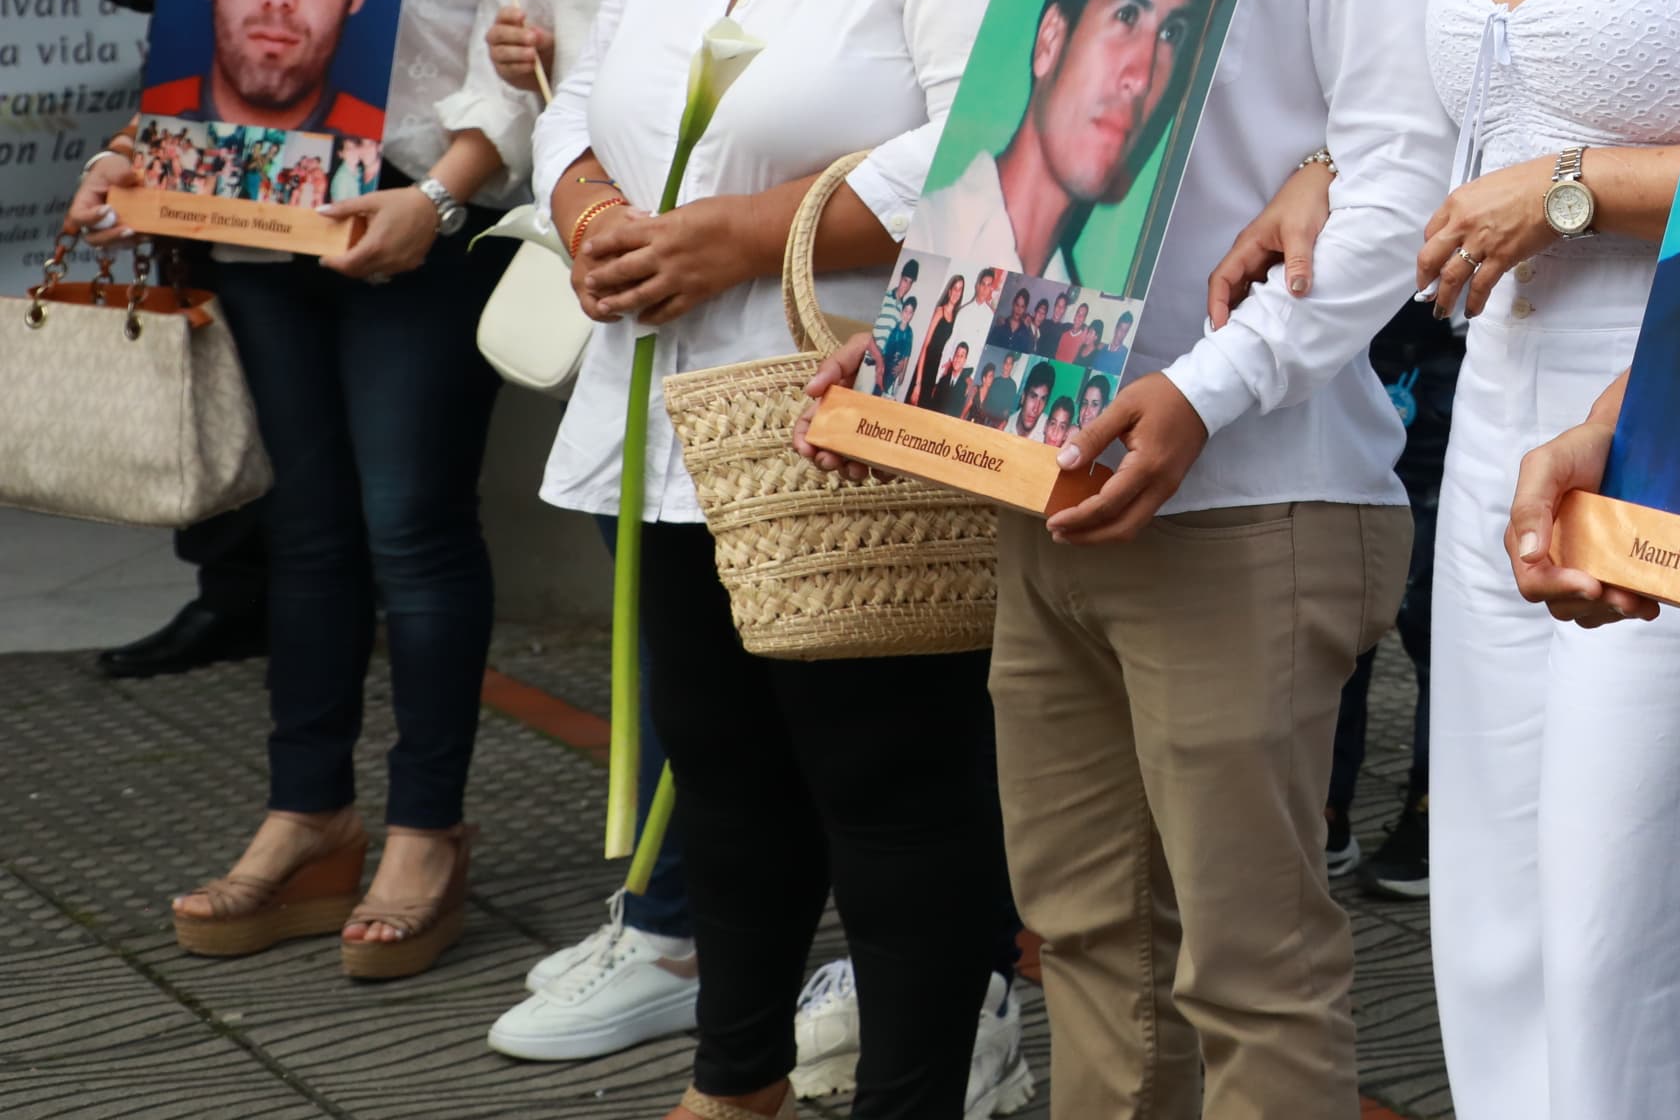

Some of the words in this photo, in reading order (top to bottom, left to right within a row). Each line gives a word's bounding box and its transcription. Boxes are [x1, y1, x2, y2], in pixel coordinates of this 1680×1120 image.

[37, 29, 118, 65] vida
[0, 84, 140, 116] antiza
[52, 130, 86, 162] la
[856, 417, 893, 443] Ruben
[895, 428, 950, 458] Fernando
[952, 443, 1004, 473] Sánchez
